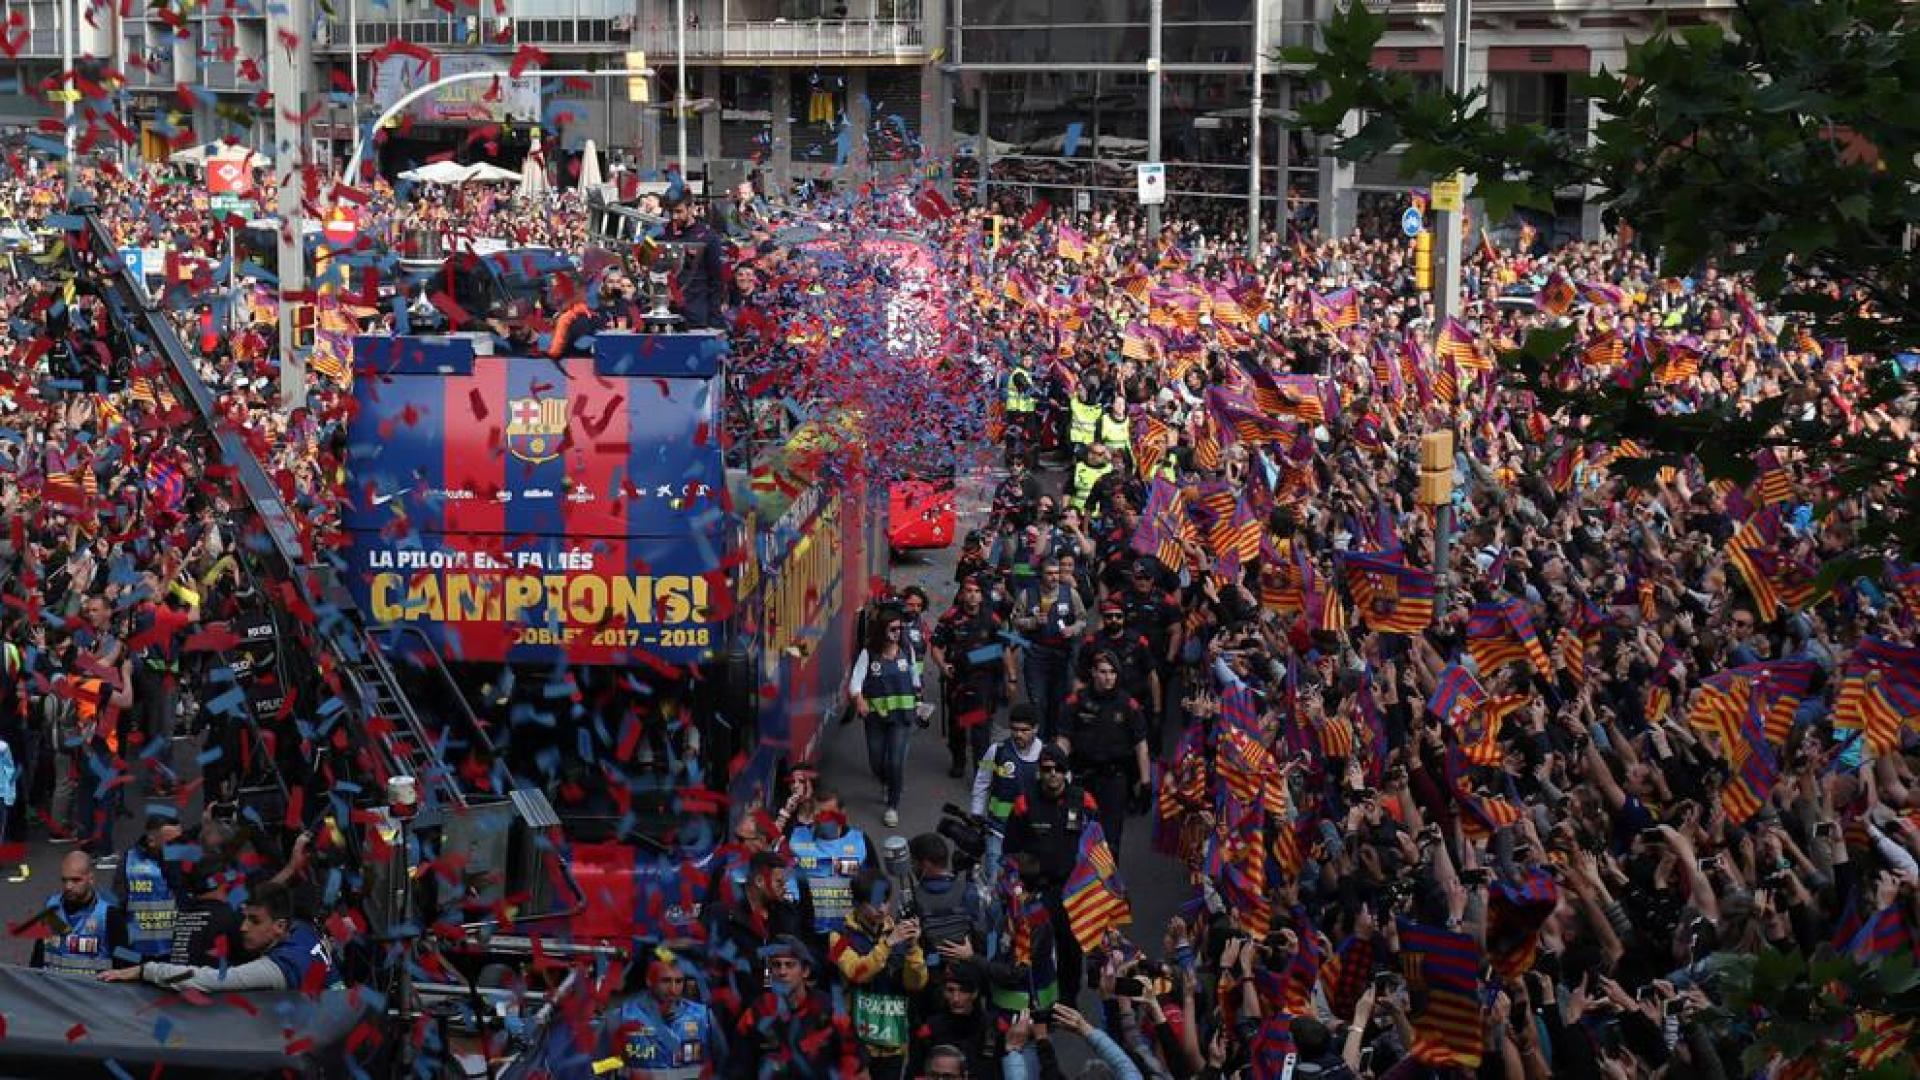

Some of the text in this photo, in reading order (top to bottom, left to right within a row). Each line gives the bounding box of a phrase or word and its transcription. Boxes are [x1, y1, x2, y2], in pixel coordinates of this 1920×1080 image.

[369, 551, 394, 568] LA
[397, 551, 468, 568] PILOTA
[518, 551, 544, 568] FA
[371, 572, 708, 624] CAMPIONS!
[591, 628, 640, 646] 2017
[660, 627, 710, 646] 2018
